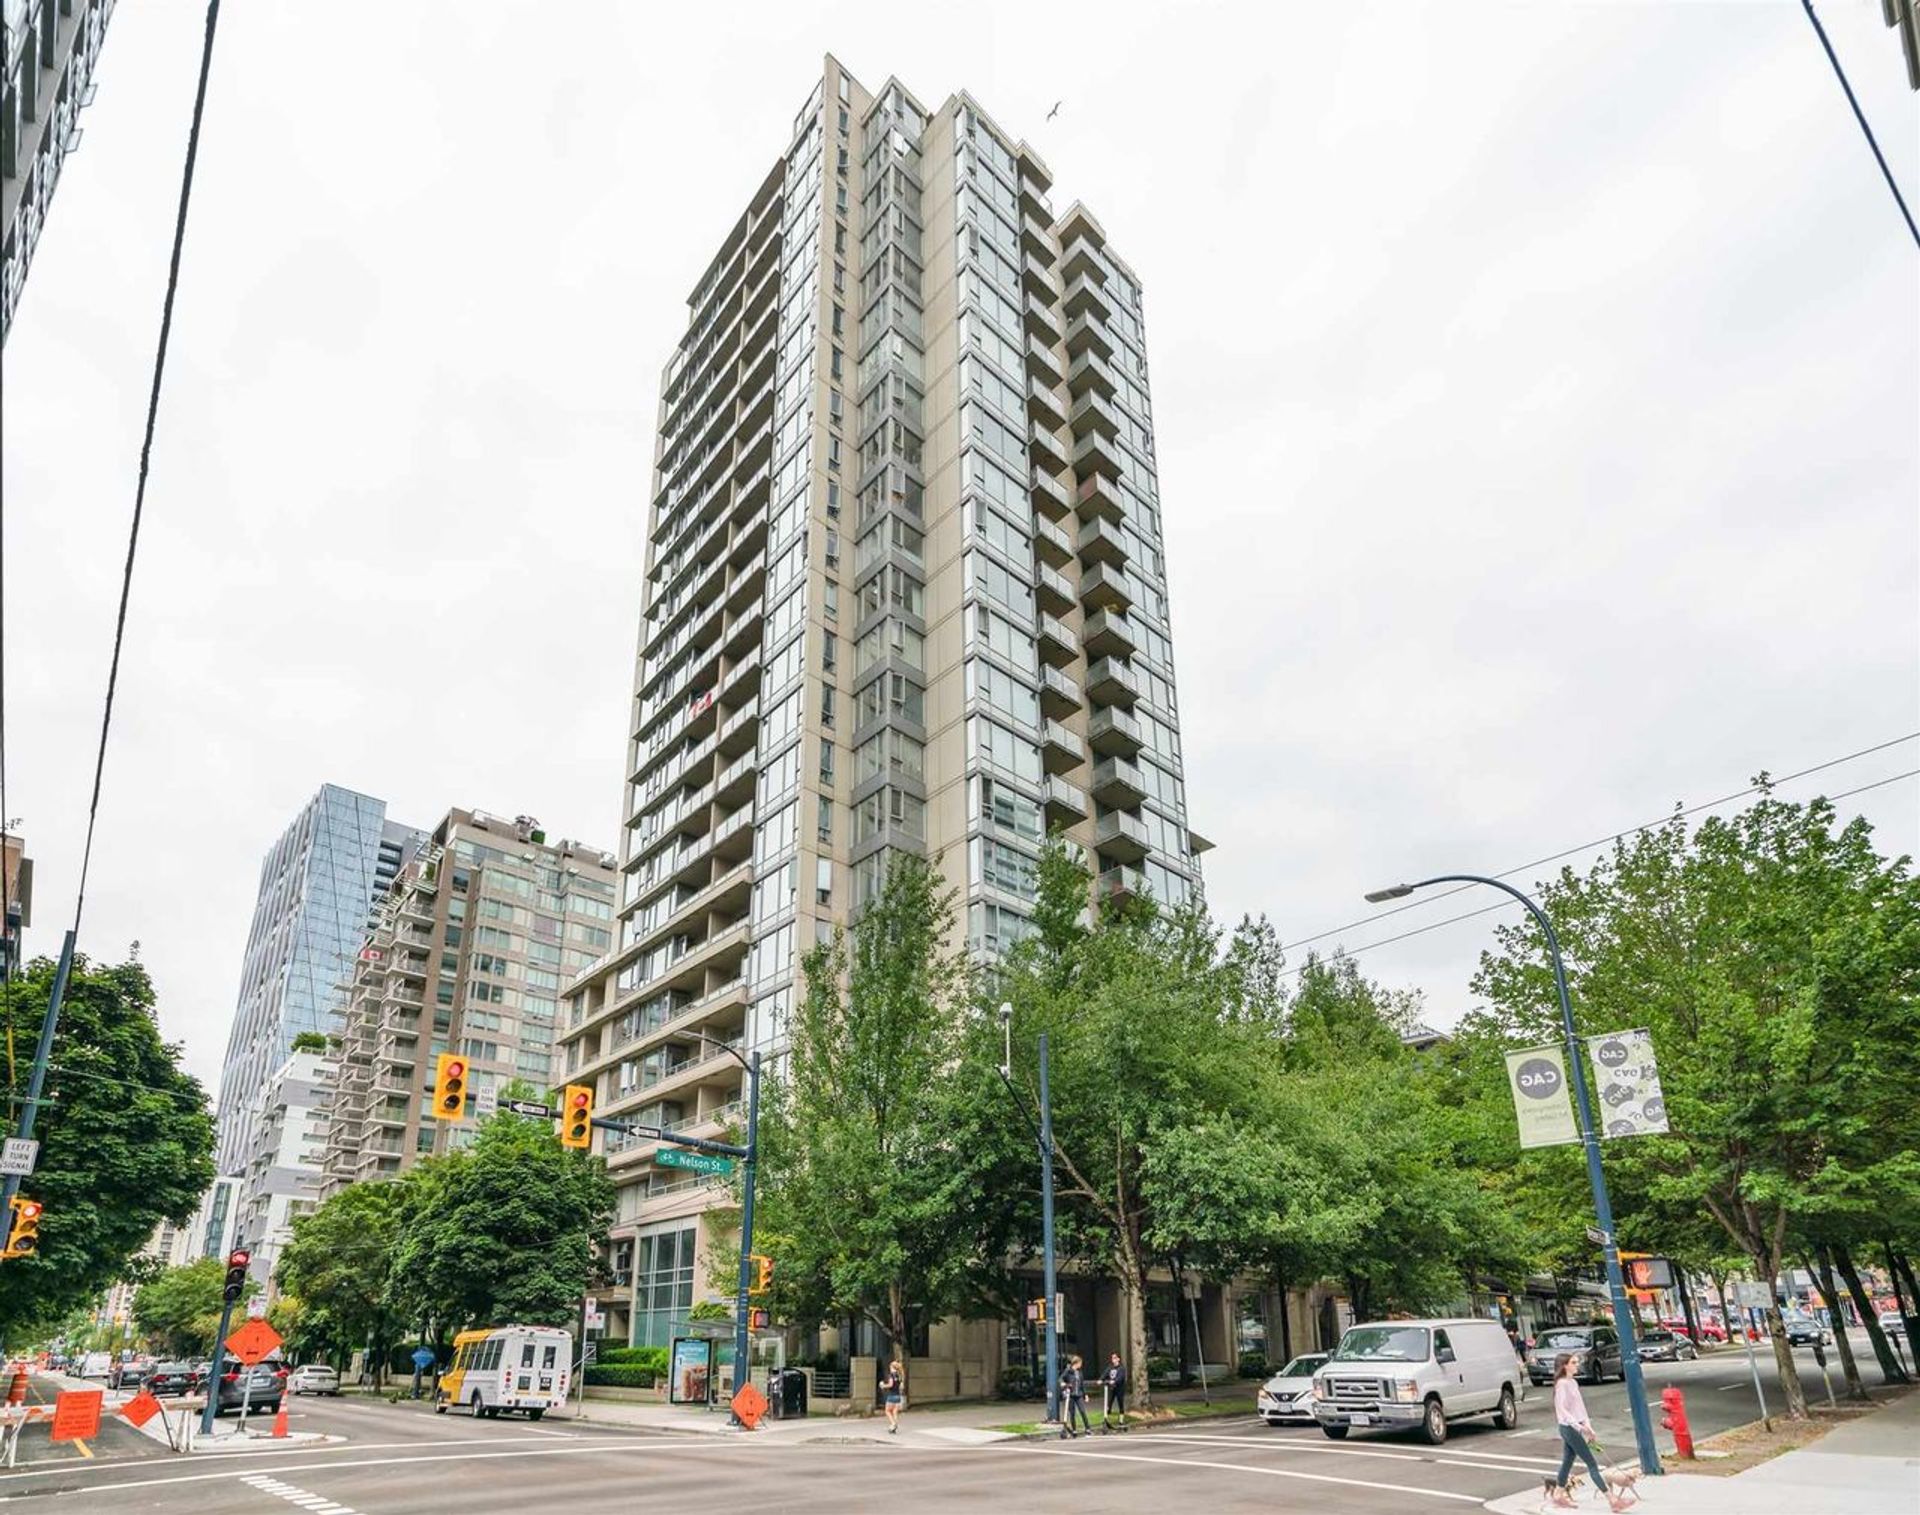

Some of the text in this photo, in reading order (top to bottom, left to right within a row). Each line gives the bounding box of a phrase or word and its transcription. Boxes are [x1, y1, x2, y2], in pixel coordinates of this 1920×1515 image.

[12, 1143, 31, 1151] LEFT
[10, 1151, 30, 1161] TURN
[679, 1156, 709, 1170] Nelson
